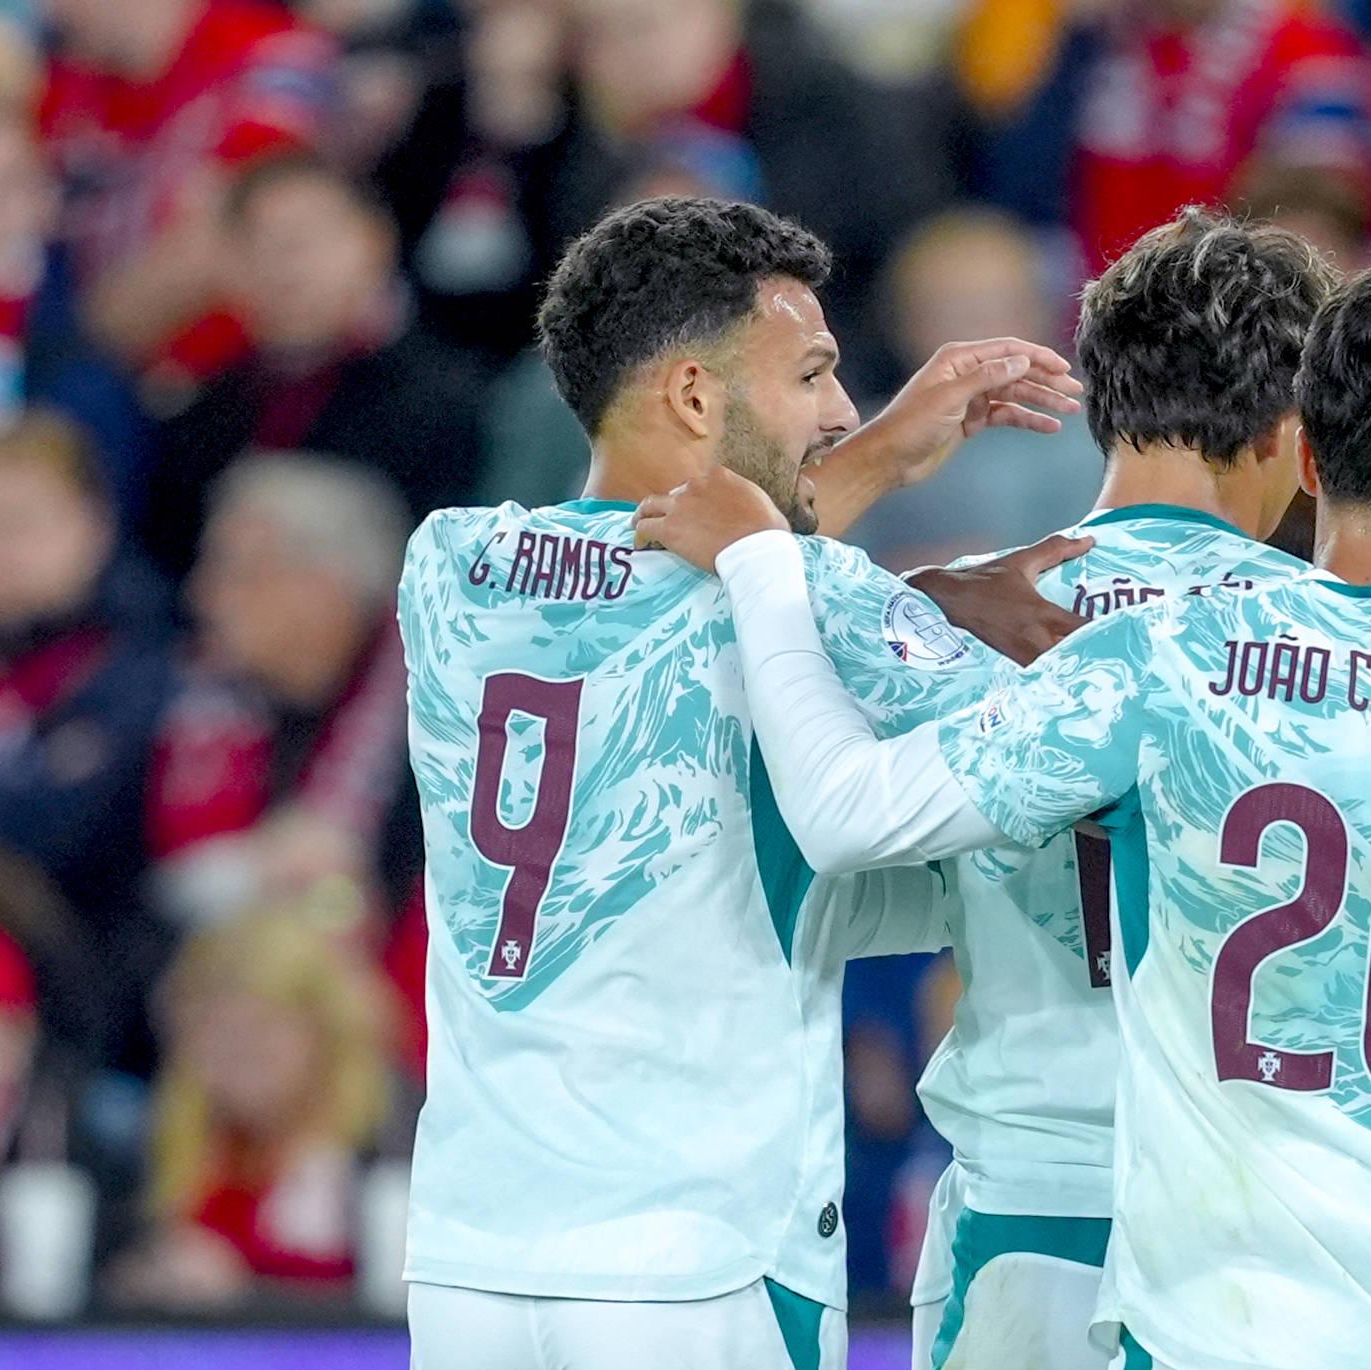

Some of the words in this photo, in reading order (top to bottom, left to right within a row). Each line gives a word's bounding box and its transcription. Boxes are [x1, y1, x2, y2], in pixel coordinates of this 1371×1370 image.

[468, 531, 507, 590] G.
[505, 531, 633, 601] RAMOS
[1208, 633, 1332, 704] JOÃO
[469, 672, 588, 981] 9
